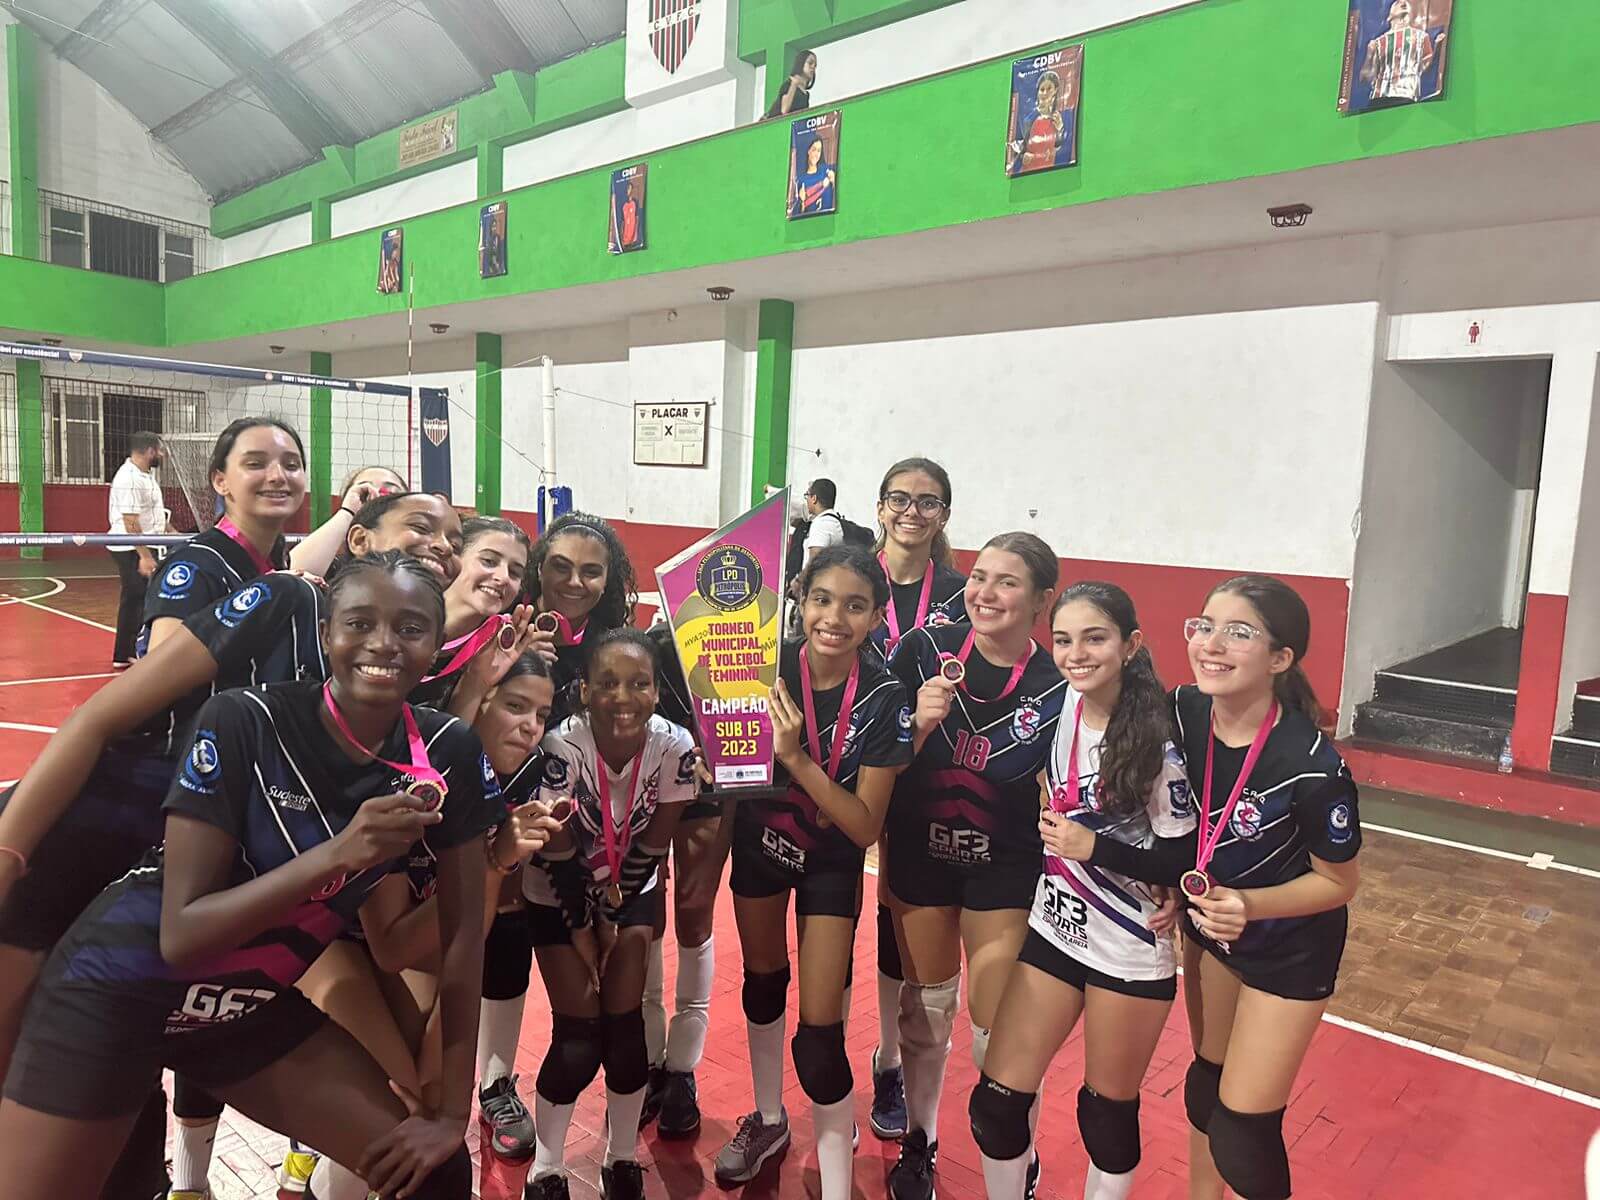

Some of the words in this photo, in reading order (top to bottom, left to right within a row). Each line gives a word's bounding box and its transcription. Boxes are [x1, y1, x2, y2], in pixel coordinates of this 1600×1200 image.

[1033, 51, 1062, 68] CDBV
[806, 115, 827, 128] CDBV
[651, 407, 689, 419] PLACAR
[664, 425, 673, 436] X
[722, 569, 738, 581] LPD
[708, 621, 754, 635] TORNEIO
[702, 637, 761, 651] MUNICIPAL
[698, 654, 712, 667] DE
[715, 651, 766, 666] VOLEIBOL
[709, 668, 759, 682] FEMININO
[702, 693, 767, 715] CAMPEÃO
[716, 721, 743, 737] SUB
[747, 720, 760, 736] 15
[721, 740, 757, 756] 2023
[952, 728, 992, 772] 18
[266, 785, 311, 806] Sudeste
[929, 822, 990, 853] GF3
